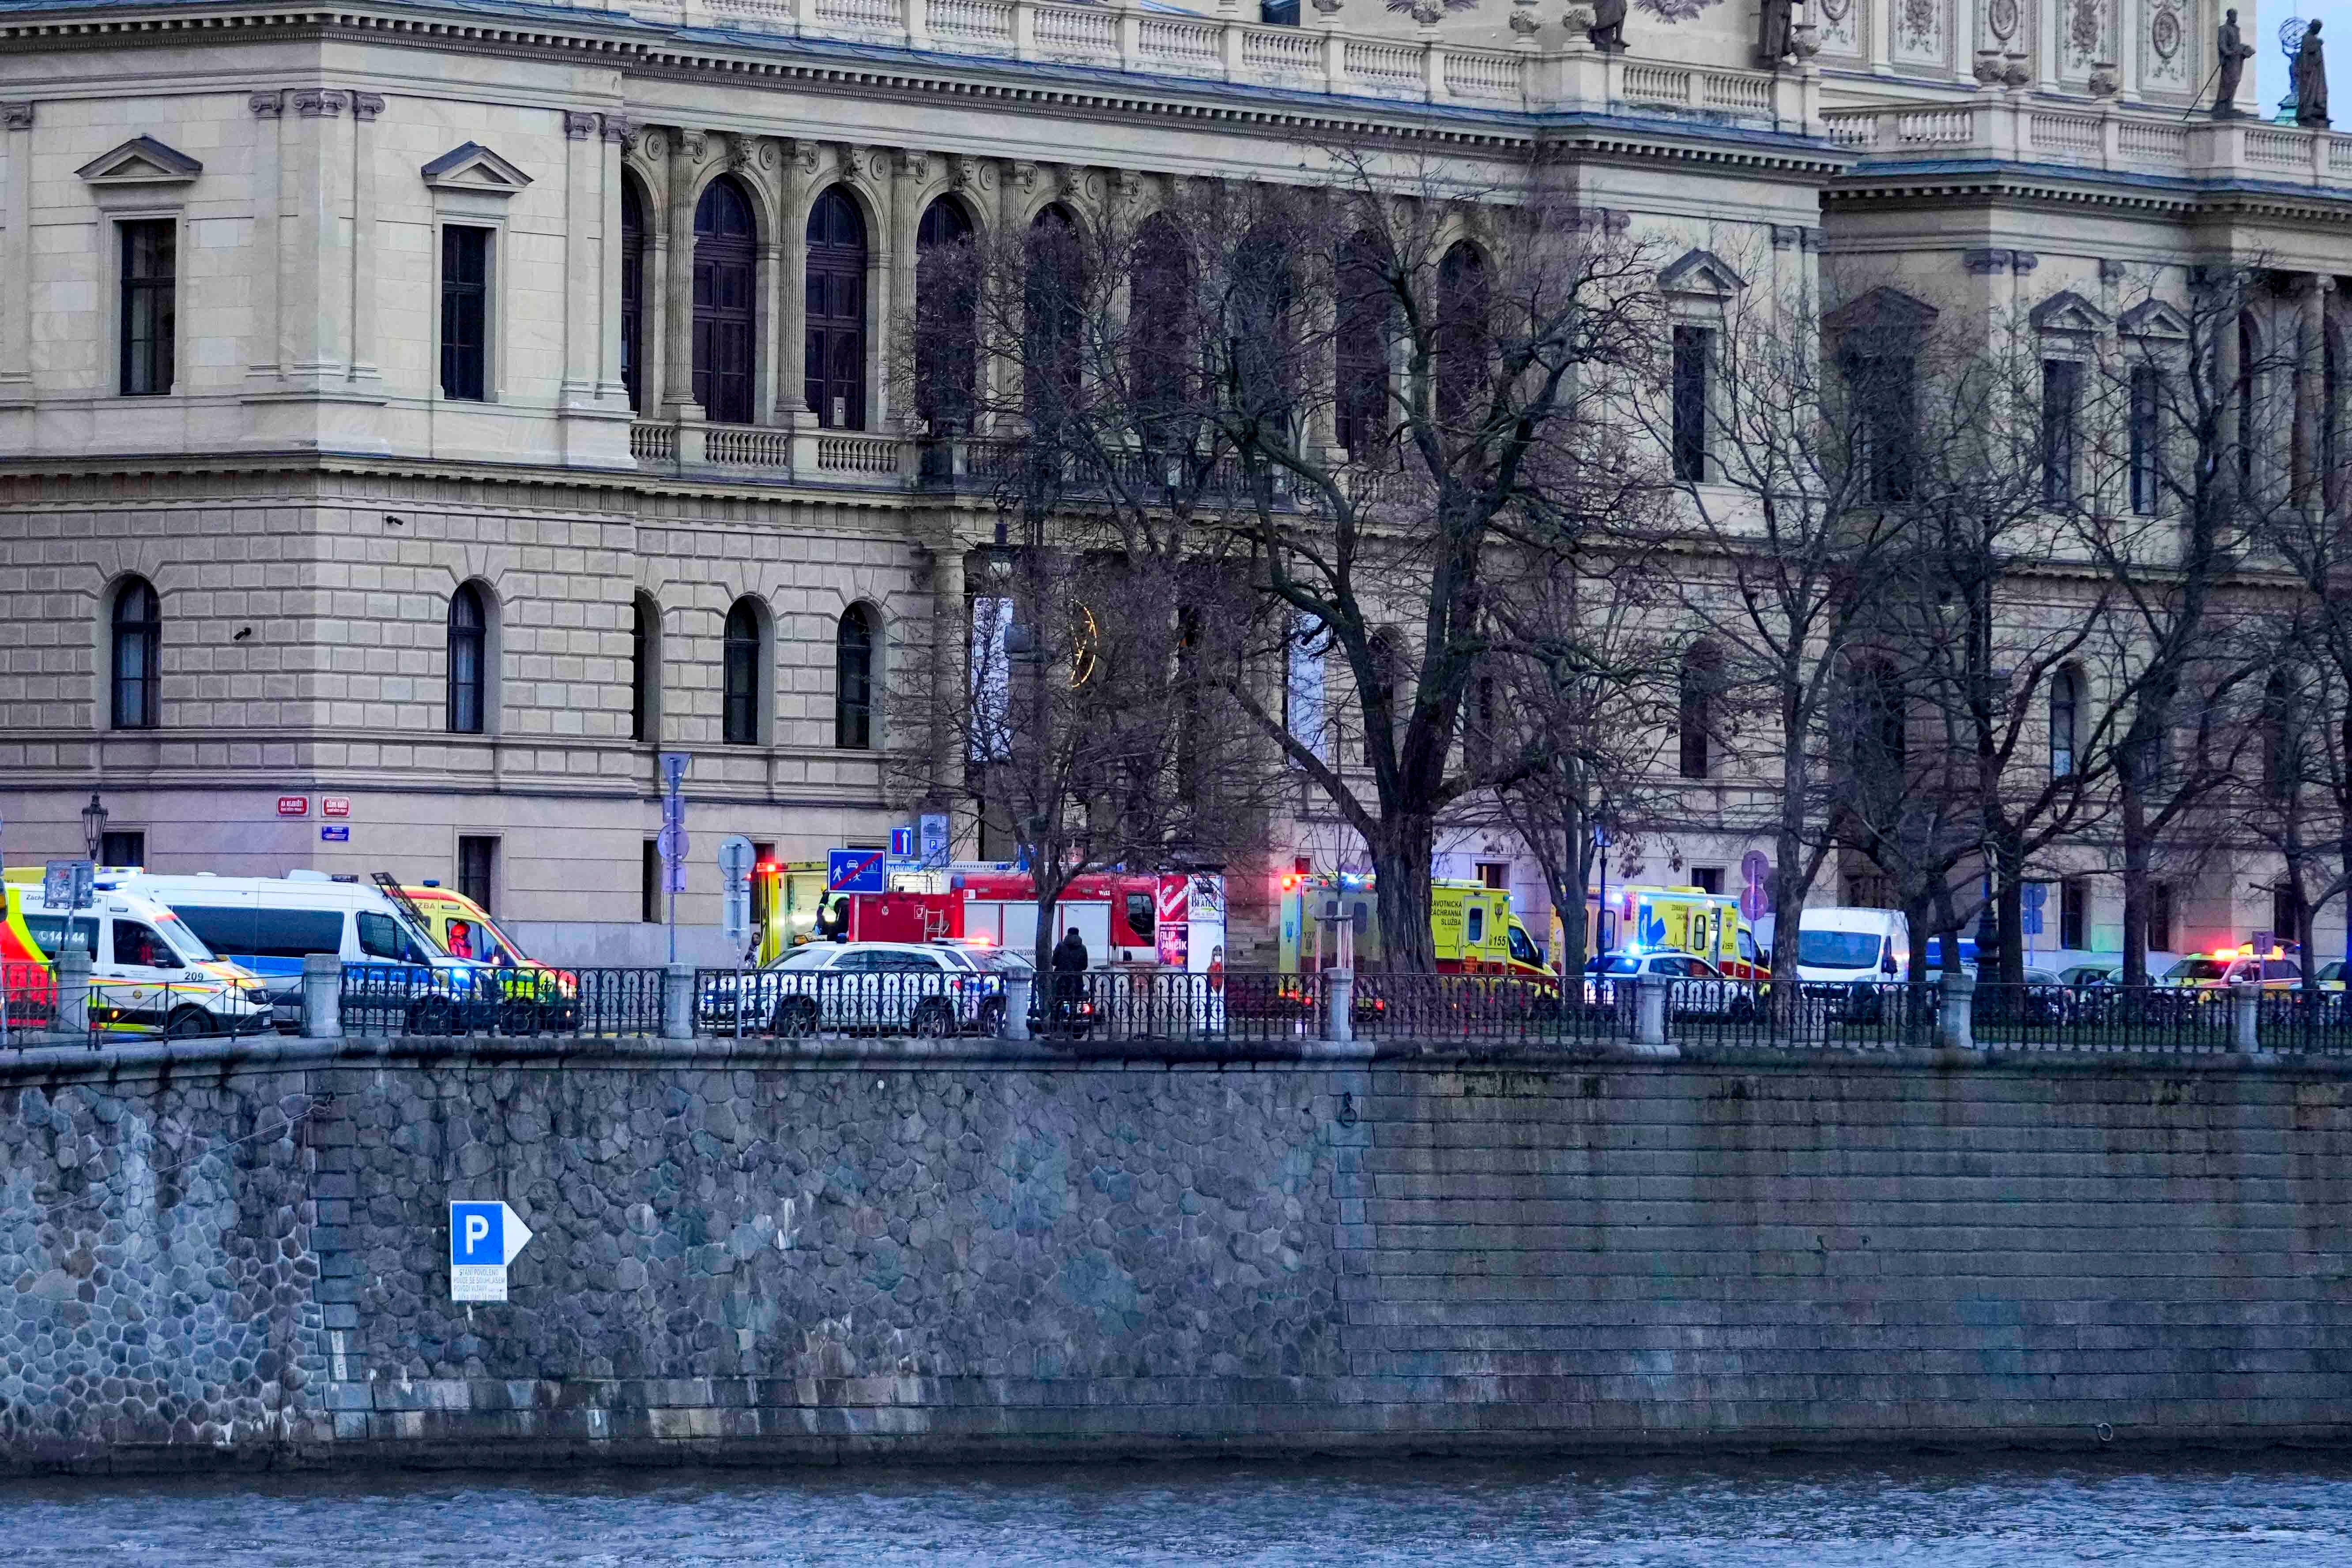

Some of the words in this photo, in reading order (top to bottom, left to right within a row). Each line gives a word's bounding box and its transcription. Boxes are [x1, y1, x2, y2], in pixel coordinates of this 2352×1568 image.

[1494, 936, 1506, 946] 155
[185, 972, 204, 981] 209
[466, 1215, 489, 1254] P
